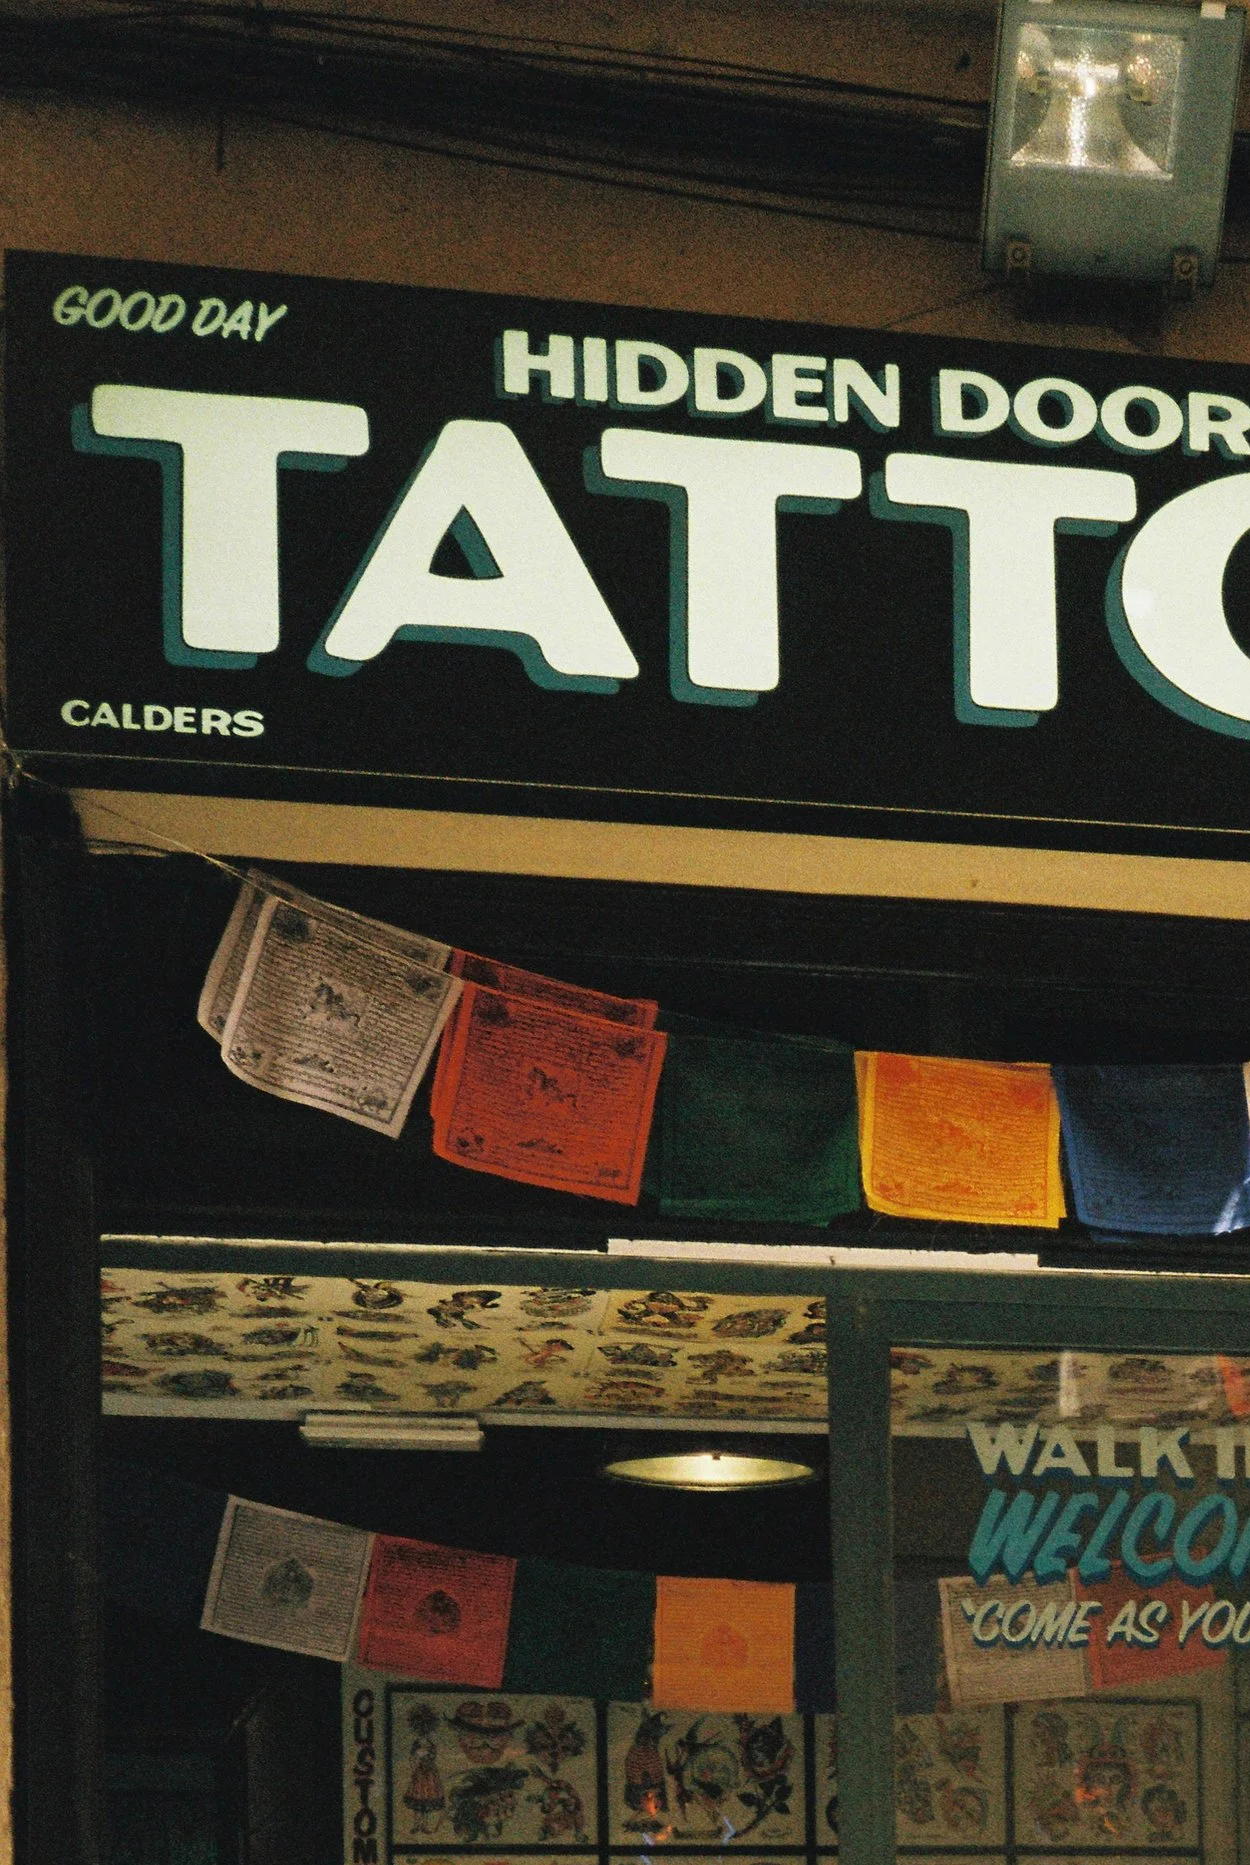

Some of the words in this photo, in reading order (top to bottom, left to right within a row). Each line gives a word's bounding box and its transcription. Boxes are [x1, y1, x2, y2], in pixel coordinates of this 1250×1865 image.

[53, 284, 186, 334] GOOD
[192, 293, 288, 343] DAY
[496, 328, 901, 432] HIDDEN
[61, 698, 265, 738] CALDERS
[965, 1421, 1196, 1487] WALK
[1106, 1599, 1168, 1648] AS
